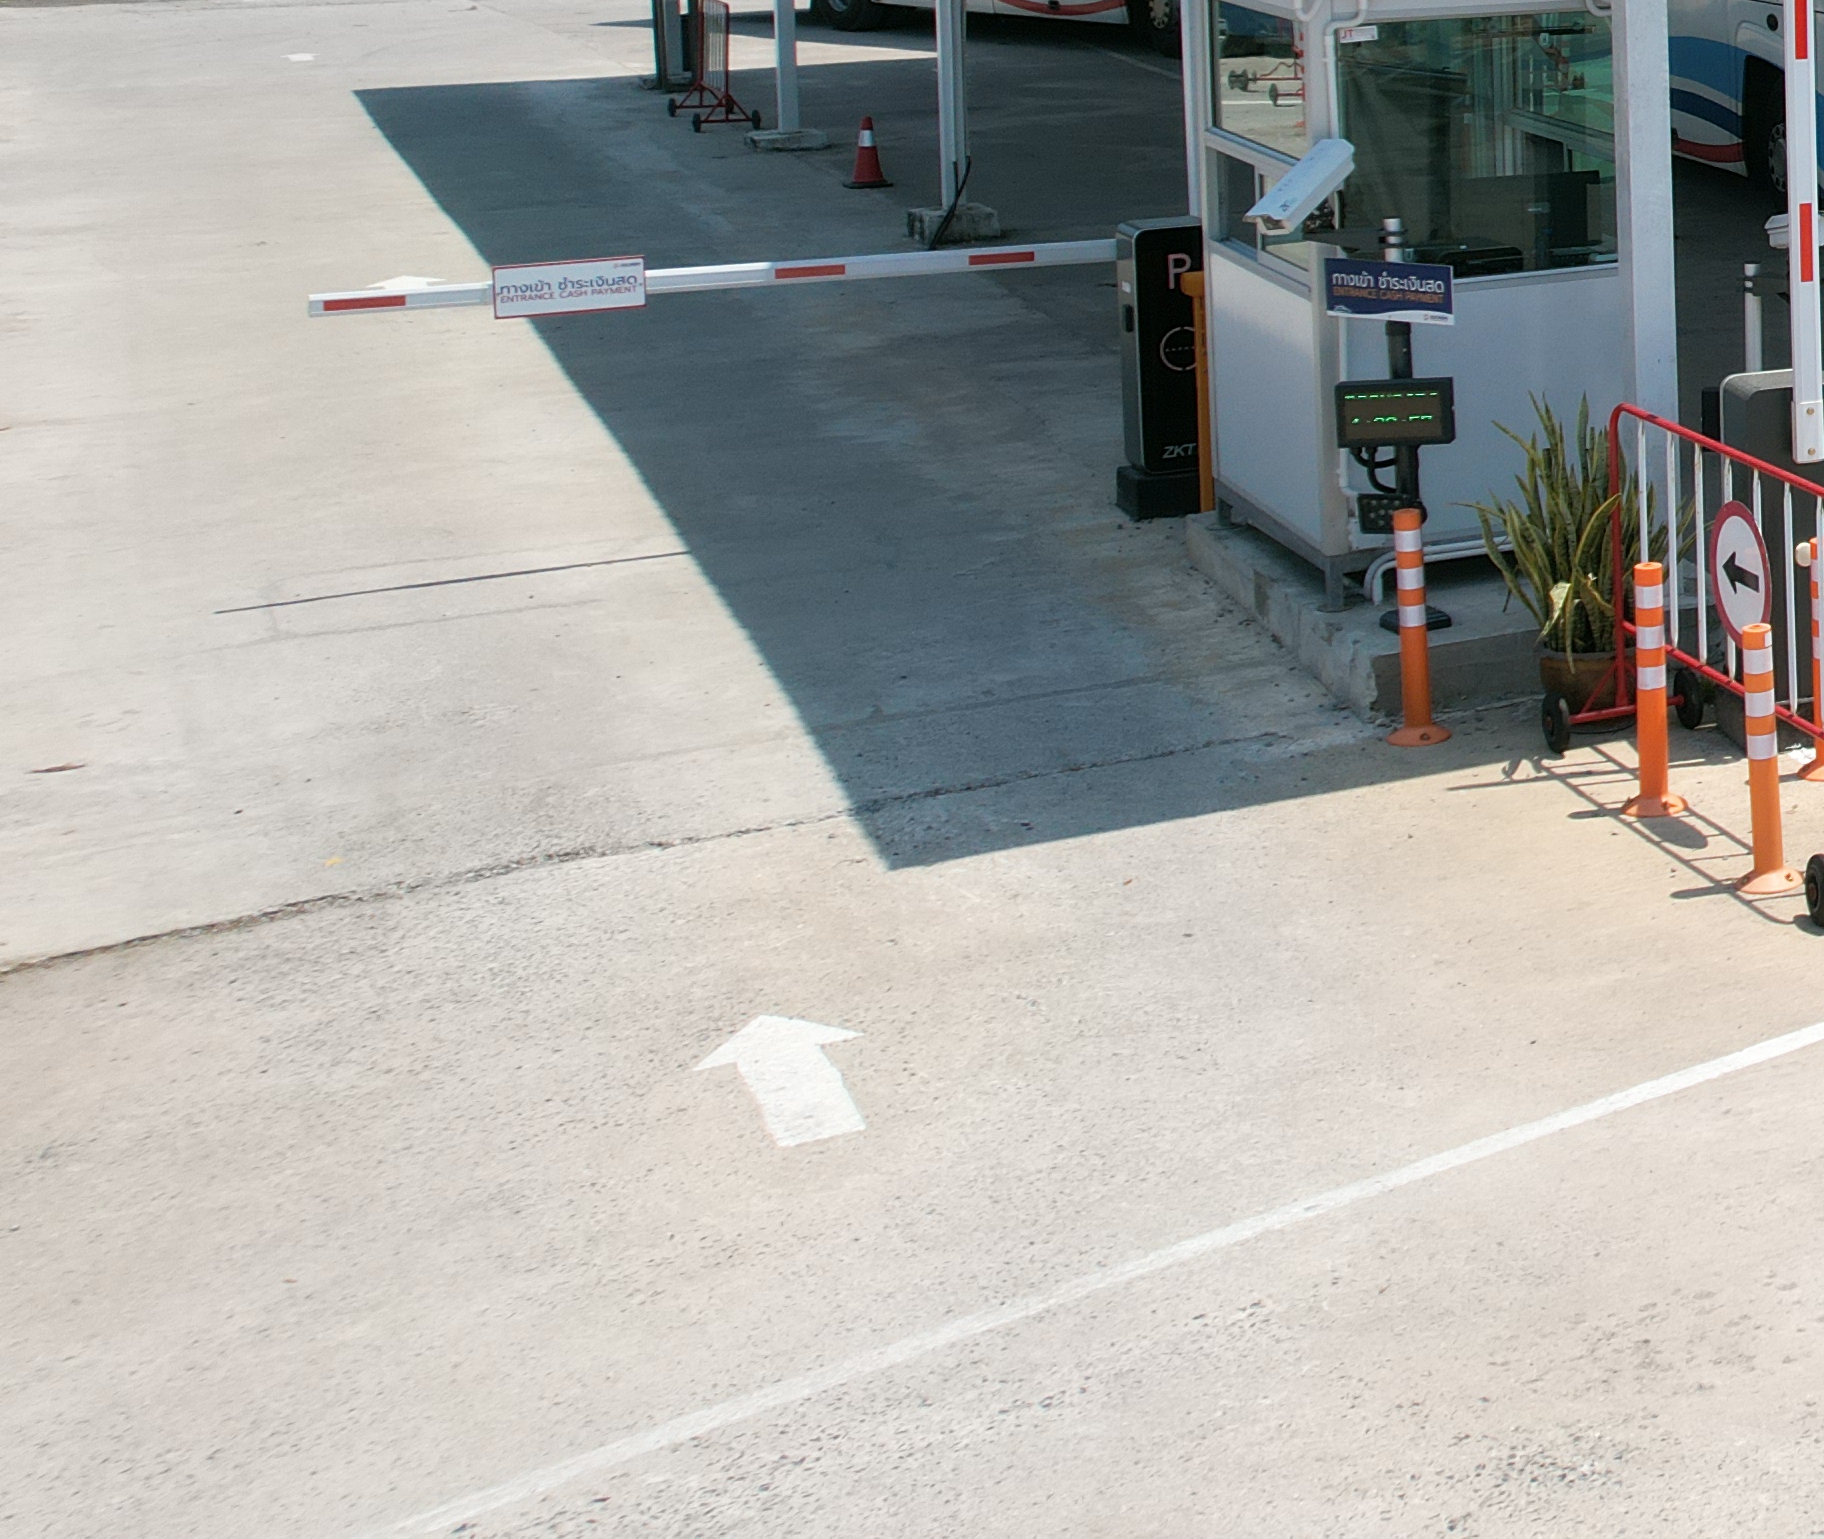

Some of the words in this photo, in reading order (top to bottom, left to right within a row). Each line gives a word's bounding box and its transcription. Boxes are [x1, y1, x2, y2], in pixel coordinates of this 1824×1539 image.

[1167, 253, 1192, 290] P
[1332, 270, 1375, 288] ทางเข้า
[1378, 271, 1445, 293] ชำระเงินสด
[500, 279, 551, 295] ทางเข้า
[558, 275, 637, 291] ชำระเงินสด
[501, 291, 555, 304] ENTRANCE
[559, 289, 588, 299] CASH
[591, 285, 637, 296] PAYMENT
[1162, 443, 1197, 459] ZKT
